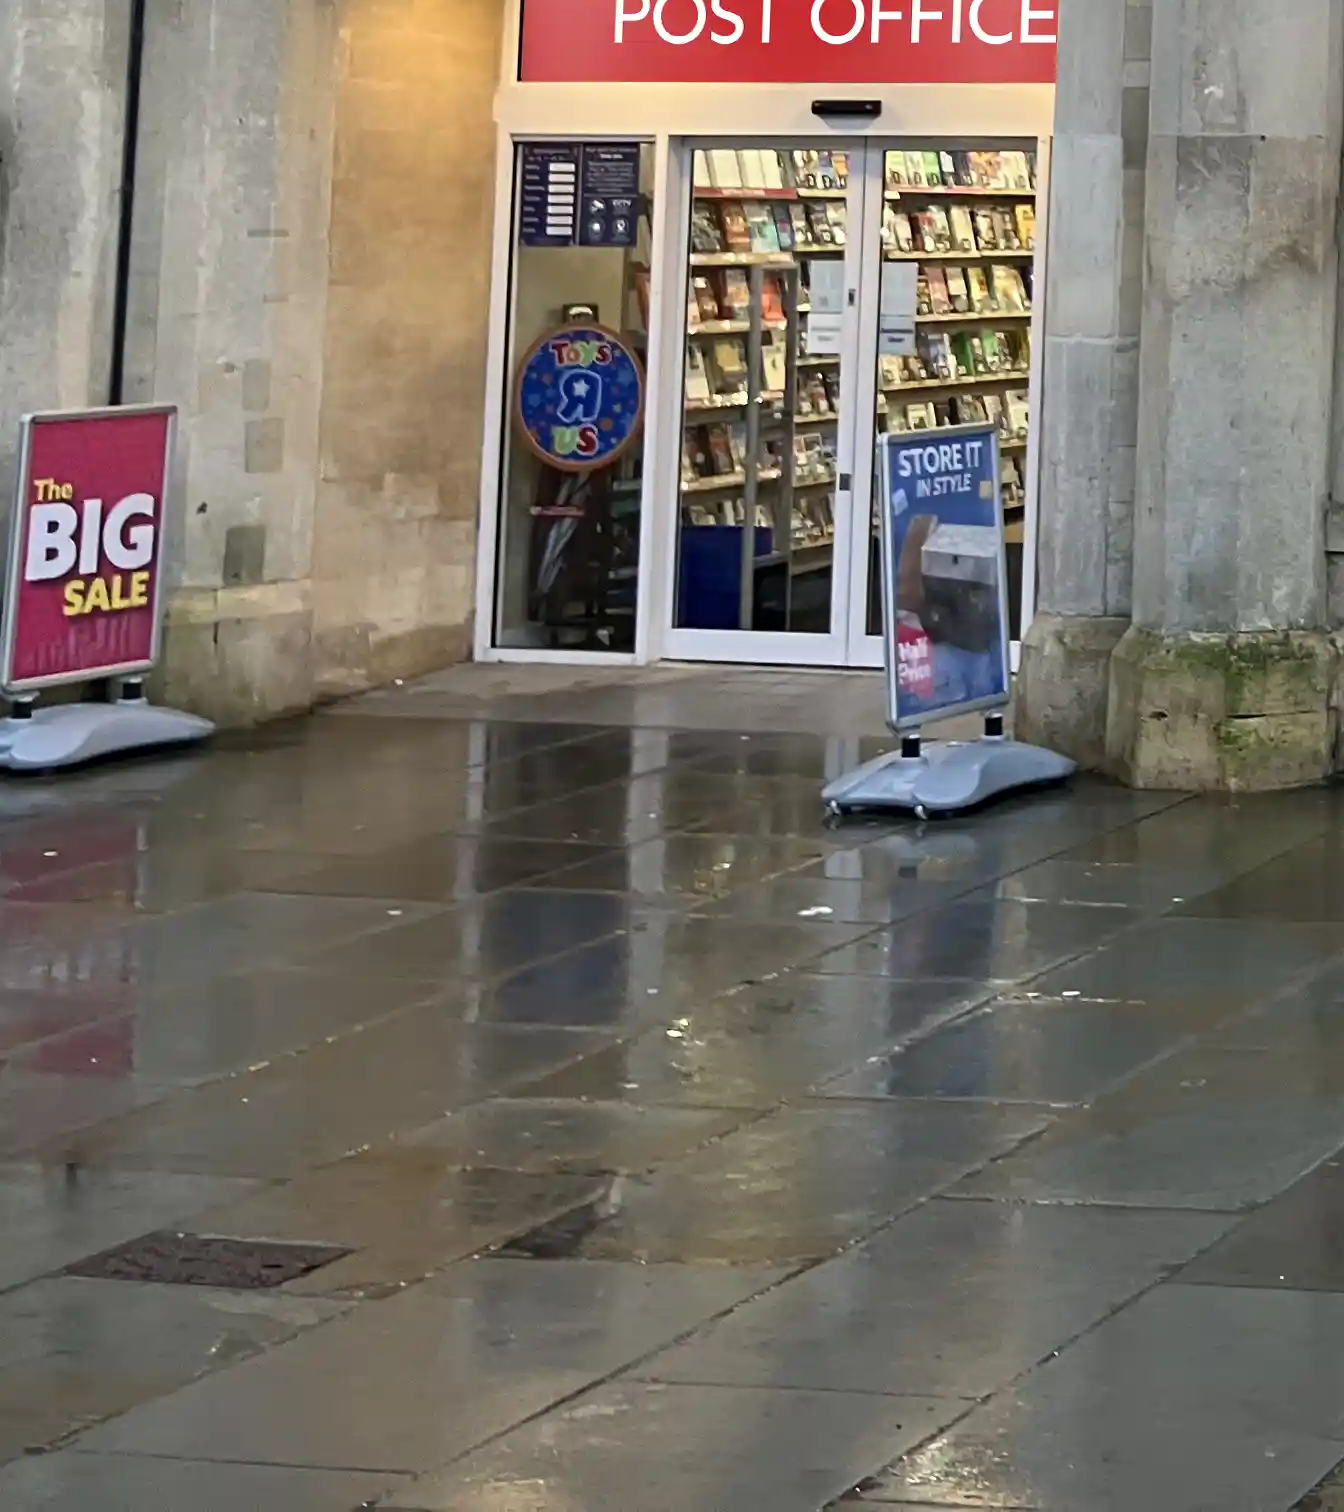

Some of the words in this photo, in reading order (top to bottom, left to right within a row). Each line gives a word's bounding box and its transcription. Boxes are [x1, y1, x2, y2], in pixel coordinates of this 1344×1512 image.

[898, 444, 963, 478] STORE
[964, 441, 983, 469] IT
[34, 478, 73, 502] The
[916, 478, 931, 498] IN
[932, 473, 972, 497] STYLE
[24, 492, 156, 582] BIG
[62, 571, 150, 617] SALE
